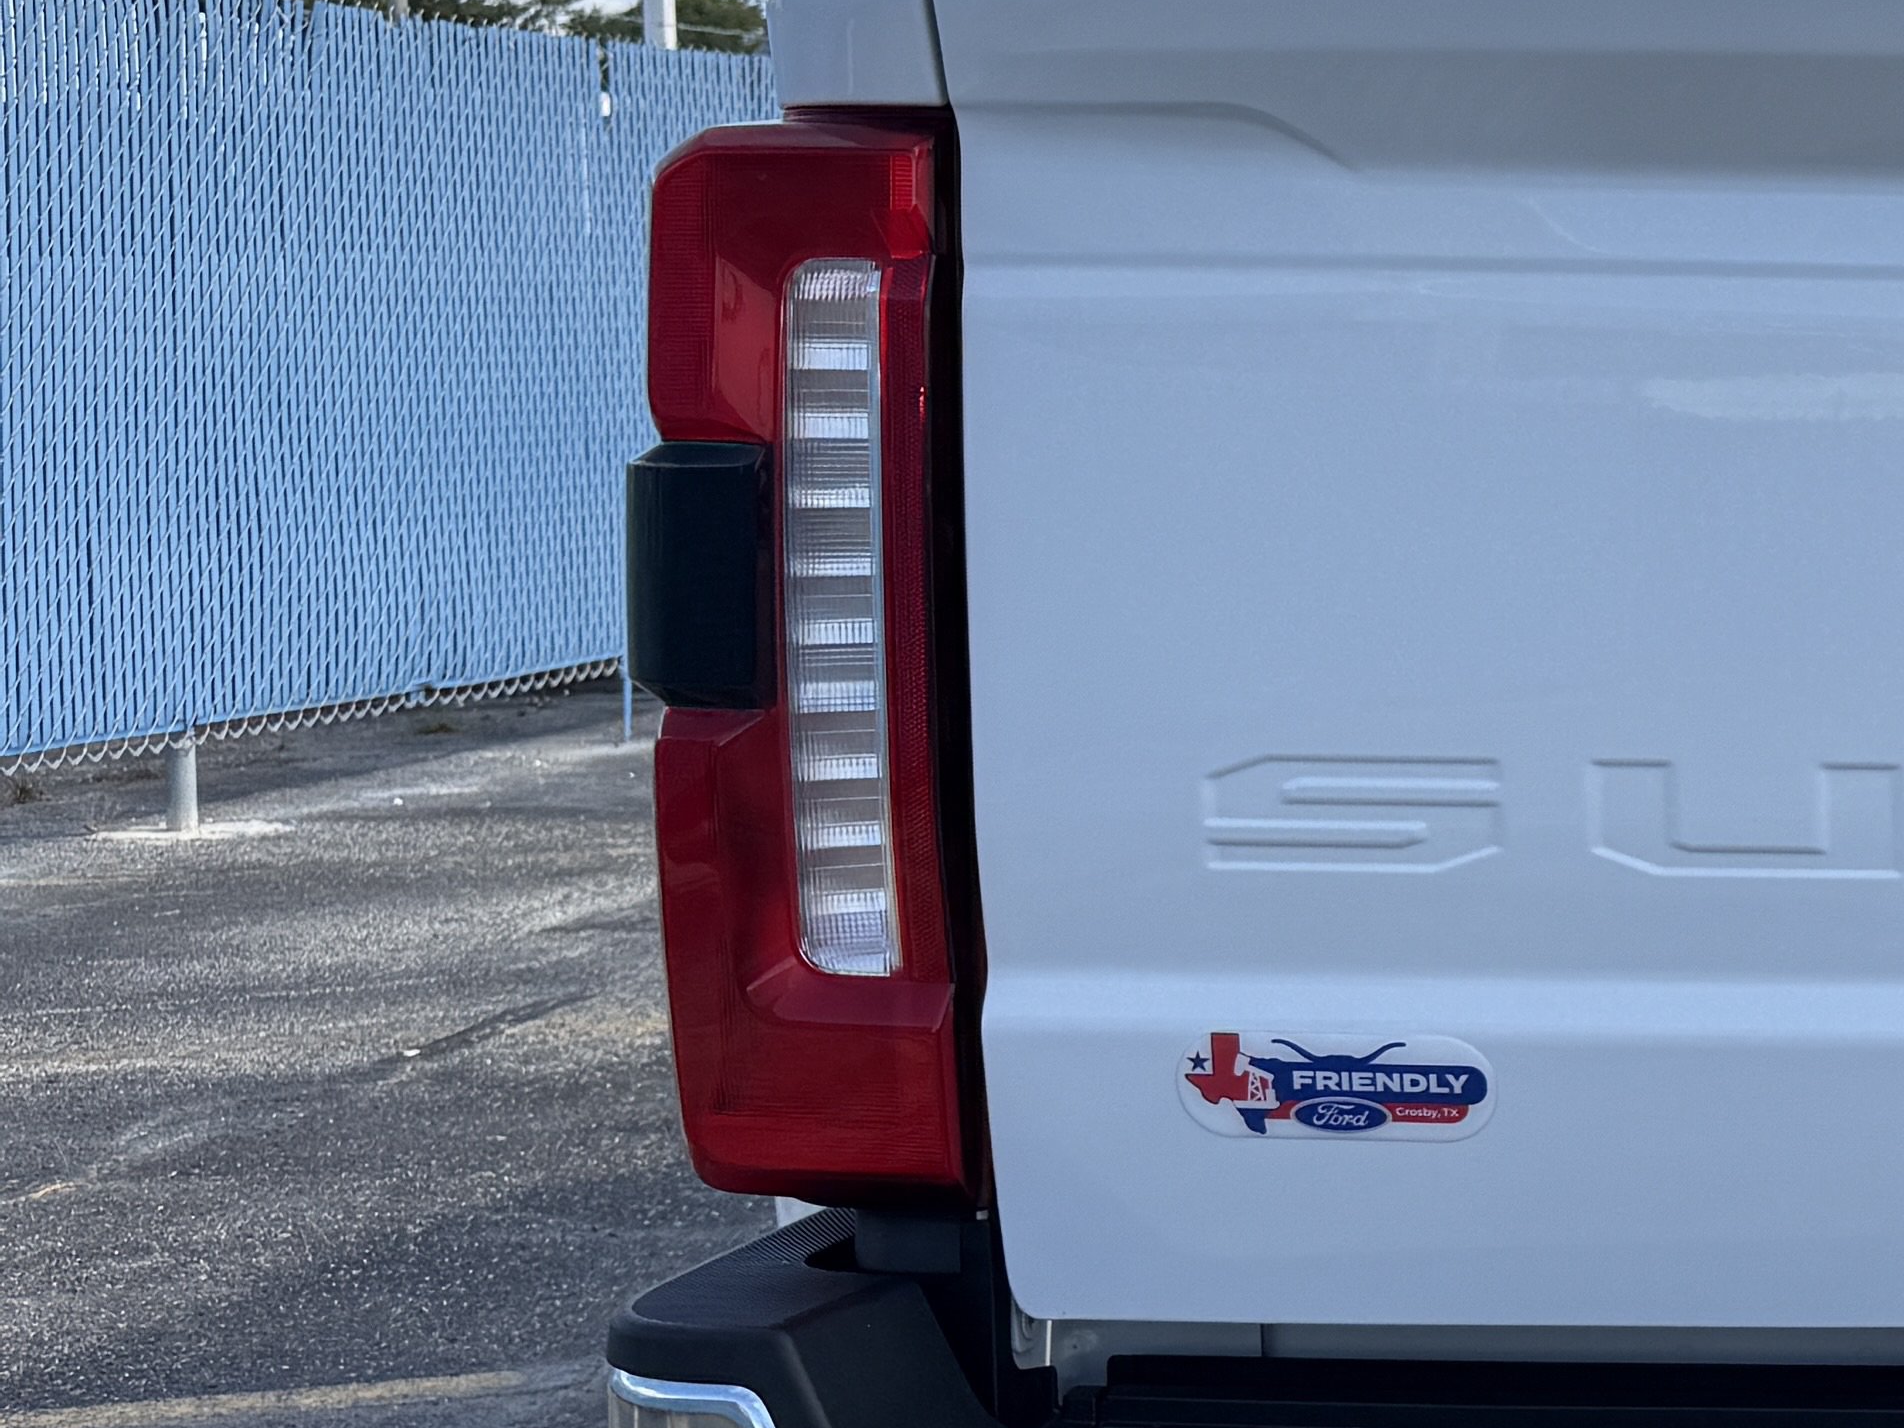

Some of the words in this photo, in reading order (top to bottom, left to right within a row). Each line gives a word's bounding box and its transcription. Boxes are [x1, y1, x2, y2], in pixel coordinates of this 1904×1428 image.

[1292, 1070, 1470, 1094] FRIENDLY
[1312, 1103, 1369, 1127] Ford
[1396, 1106, 1441, 1119] Crosby,
[1443, 1109, 1460, 1118] TX
